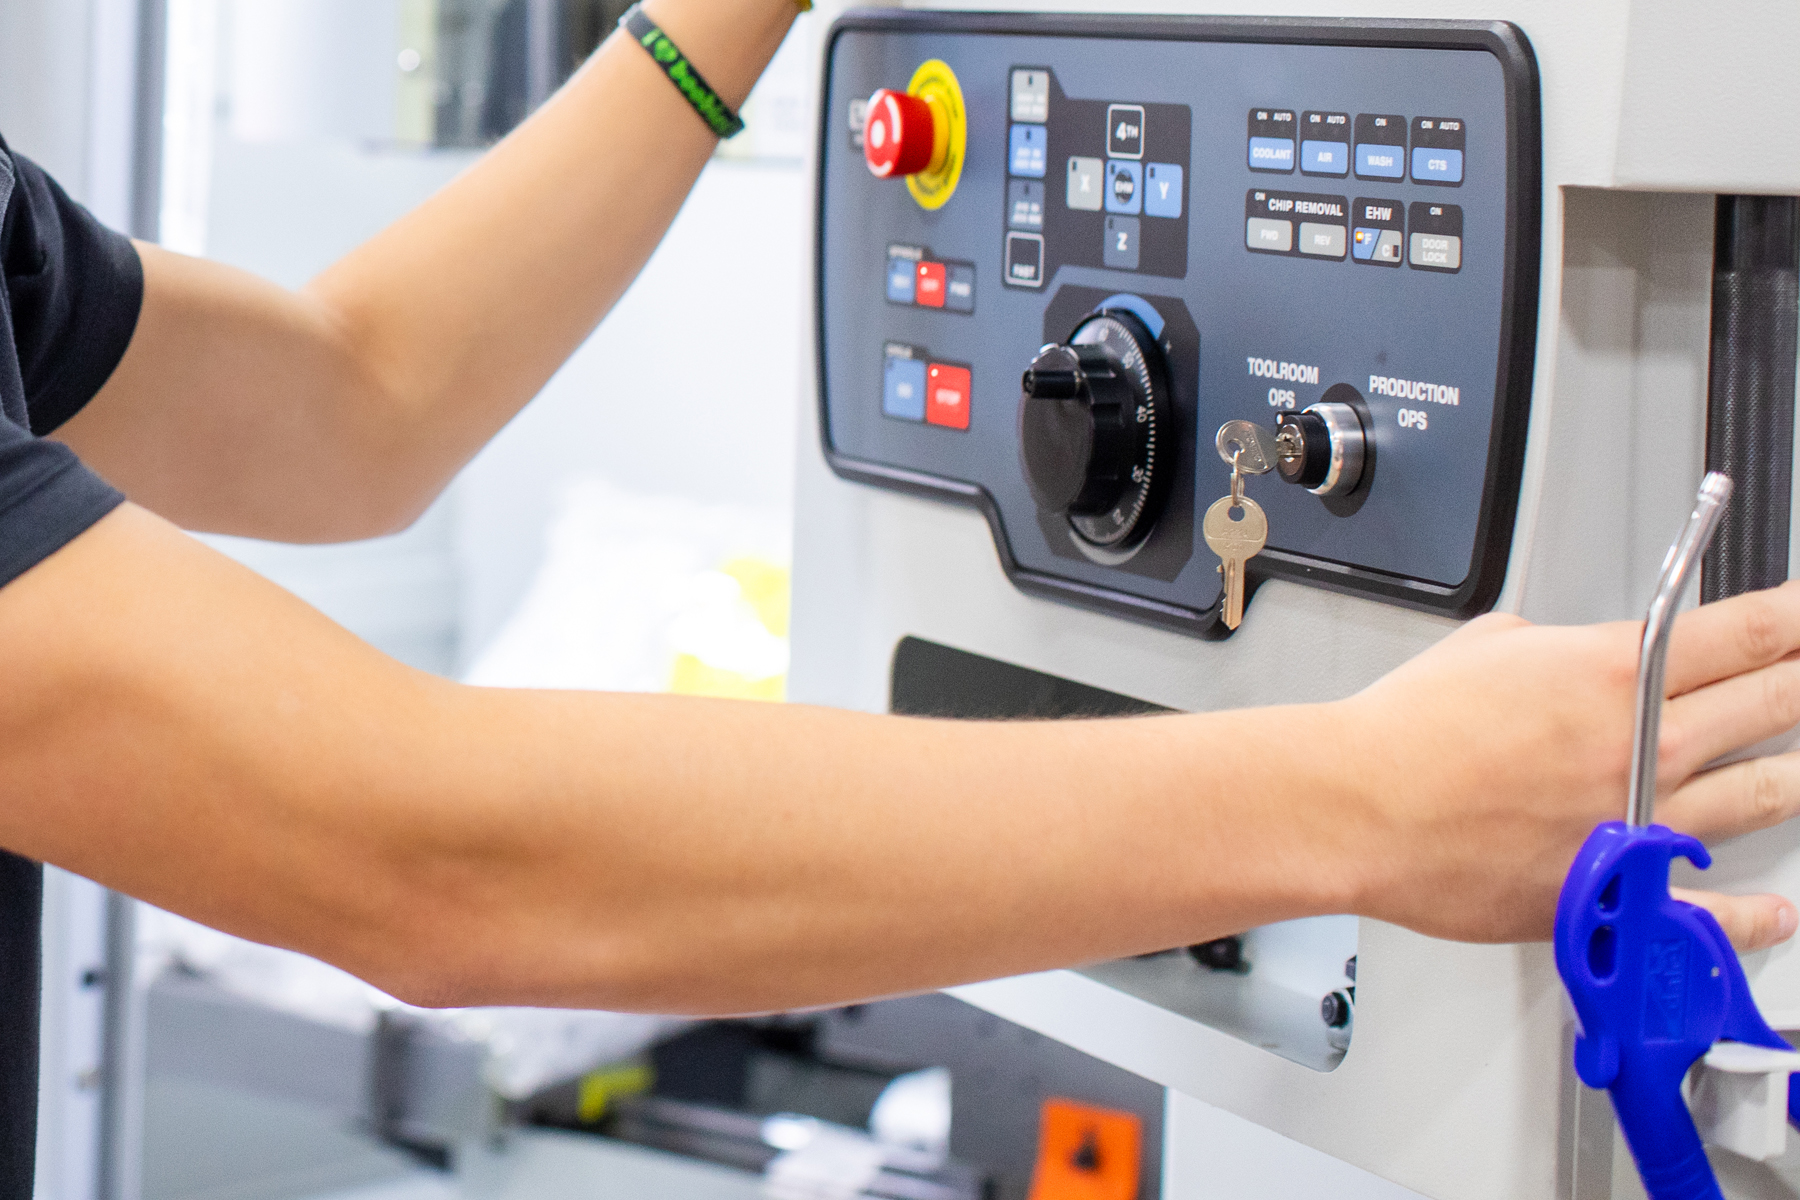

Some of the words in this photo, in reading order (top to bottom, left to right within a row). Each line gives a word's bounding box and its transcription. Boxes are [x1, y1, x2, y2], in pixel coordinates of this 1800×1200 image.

[1257, 111, 1268, 120] ON
[1273, 112, 1292, 121] AUTO
[1309, 114, 1321, 123] ON
[1326, 115, 1346, 124] AUTO
[1375, 118, 1387, 126] ON
[1421, 120, 1433, 129] ON
[1439, 121, 1460, 130] AUTO
[1252, 147, 1292, 160] COOLANT
[1317, 152, 1333, 163] AIR
[1367, 155, 1393, 167] WASH
[1428, 159, 1447, 171] CTS
[1159, 181, 1170, 200] Y
[1254, 191, 1266, 201] ON
[1268, 198, 1294, 212] CHIP
[1295, 200, 1344, 216] REMOVAL
[1365, 205, 1393, 221] EHW
[1429, 207, 1443, 216] ON
[1116, 231, 1128, 251] Z
[1313, 234, 1332, 246] REV
[1422, 238, 1449, 250] DOOR
[1422, 251, 1448, 263] LOCK
[1247, 356, 1319, 384] TOOLROOM
[1368, 374, 1460, 406] PRODUCTION
[1268, 387, 1295, 409] OPS
[1398, 408, 1428, 430] OPS
